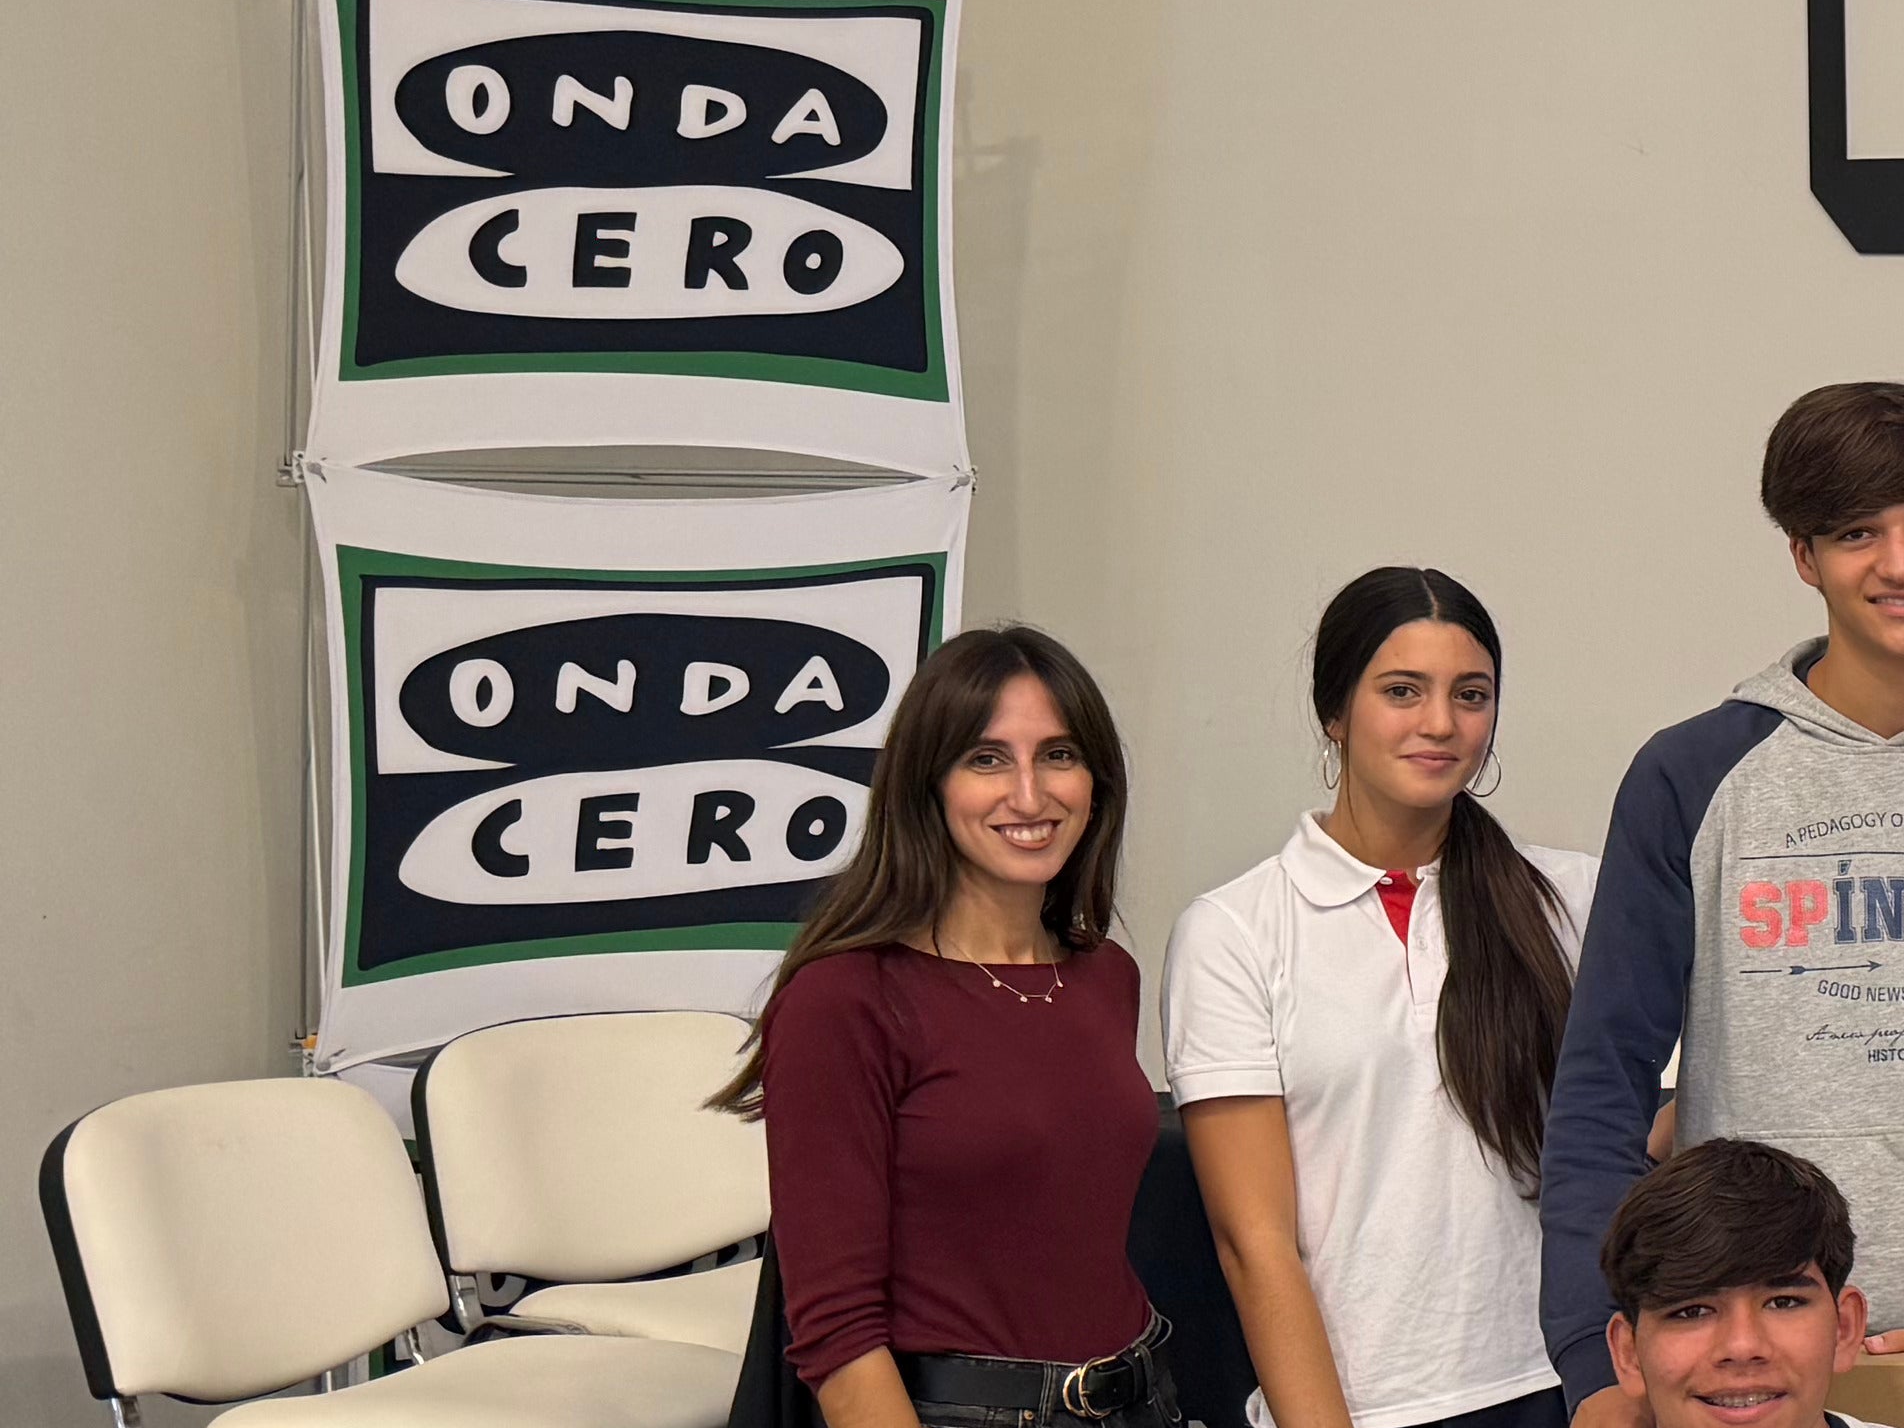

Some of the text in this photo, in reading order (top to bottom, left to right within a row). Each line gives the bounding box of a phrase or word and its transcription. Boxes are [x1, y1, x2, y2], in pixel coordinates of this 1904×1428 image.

[446, 63, 845, 147] ONDA
[468, 208, 845, 296] CERO
[449, 658, 846, 728] ONDA
[471, 791, 848, 878] CERO
[1785, 832, 1797, 848] A
[1798, 812, 1887, 844] PEDAGOGY
[1817, 979, 1860, 1001] GOOD
